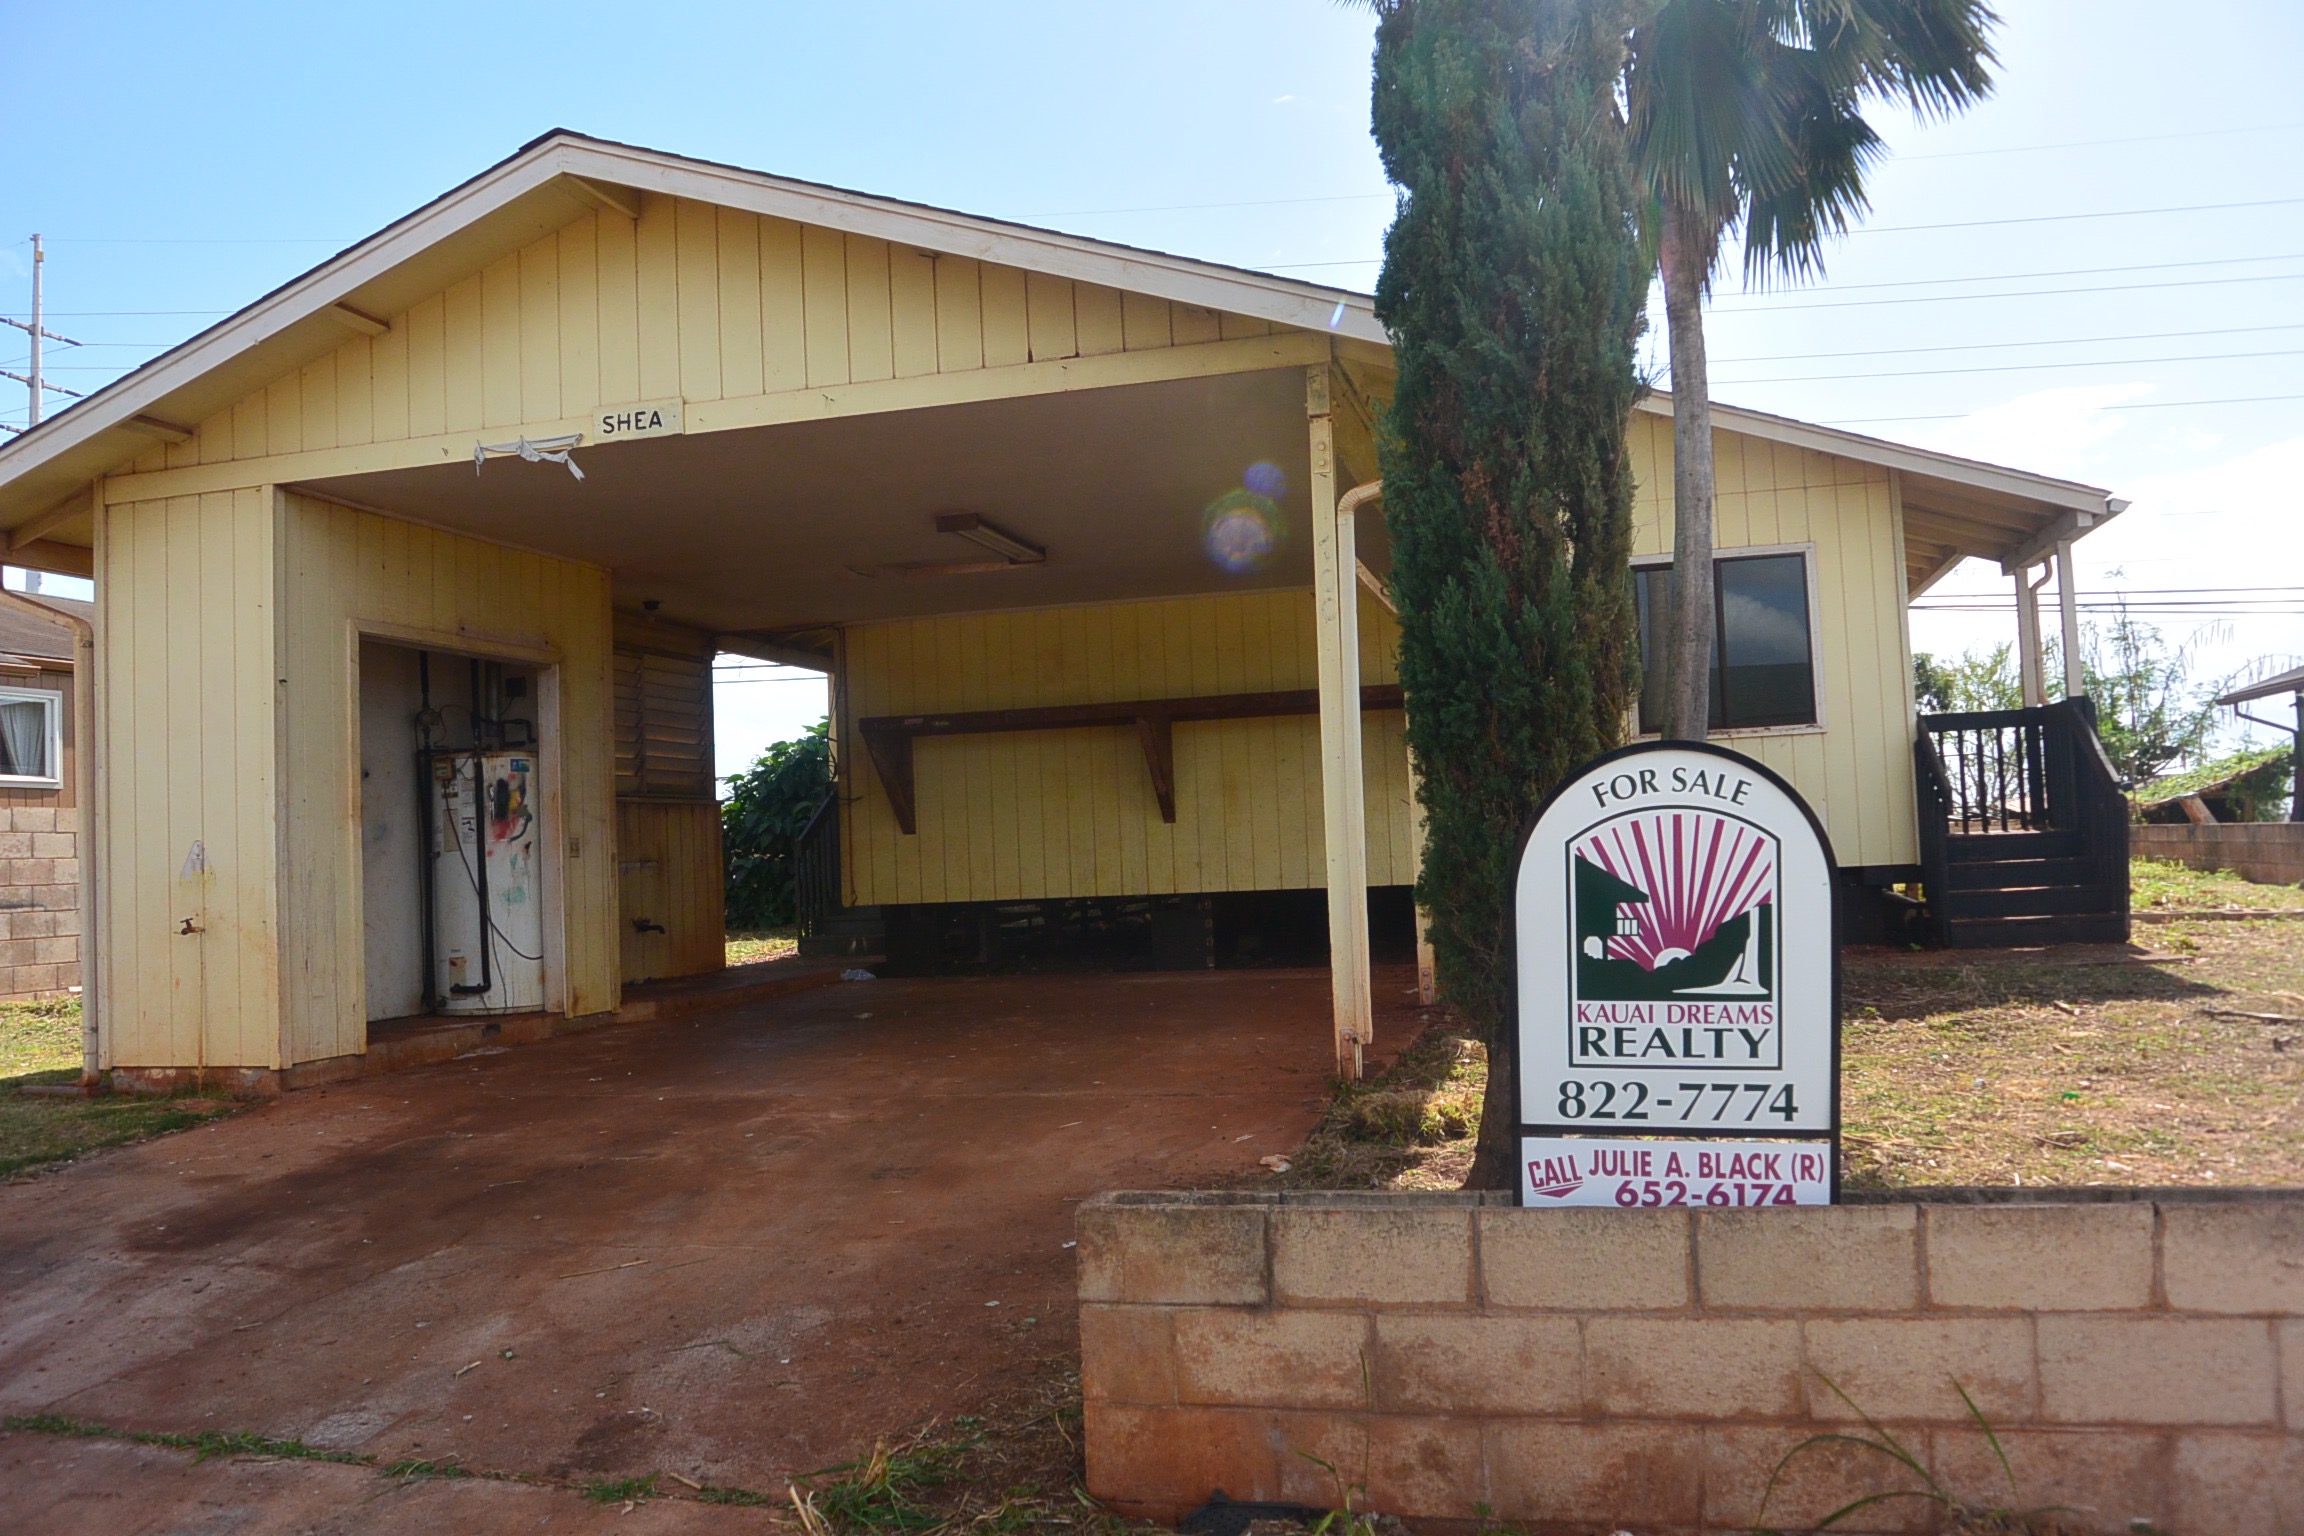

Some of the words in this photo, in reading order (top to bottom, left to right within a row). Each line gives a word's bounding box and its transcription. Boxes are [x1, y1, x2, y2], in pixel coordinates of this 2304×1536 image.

[602, 410, 663, 434] SHEA
[1591, 769, 1660, 808] FOR
[1671, 767, 1752, 806] SALE
[1577, 1003, 1653, 1024] KAUAI
[1667, 1004, 1774, 1025] DREAMS
[1578, 1026, 1771, 1059] REALTY
[1557, 1080, 1799, 1122] 822-7774
[1528, 1154, 1583, 1189] CALL
[1588, 1149, 1651, 1178] JULIE
[1665, 1151, 1690, 1179] A.
[1698, 1152, 1781, 1181] BLACK
[1791, 1153, 1825, 1184] (R)
[1614, 1180, 1797, 1207] 652-6174
